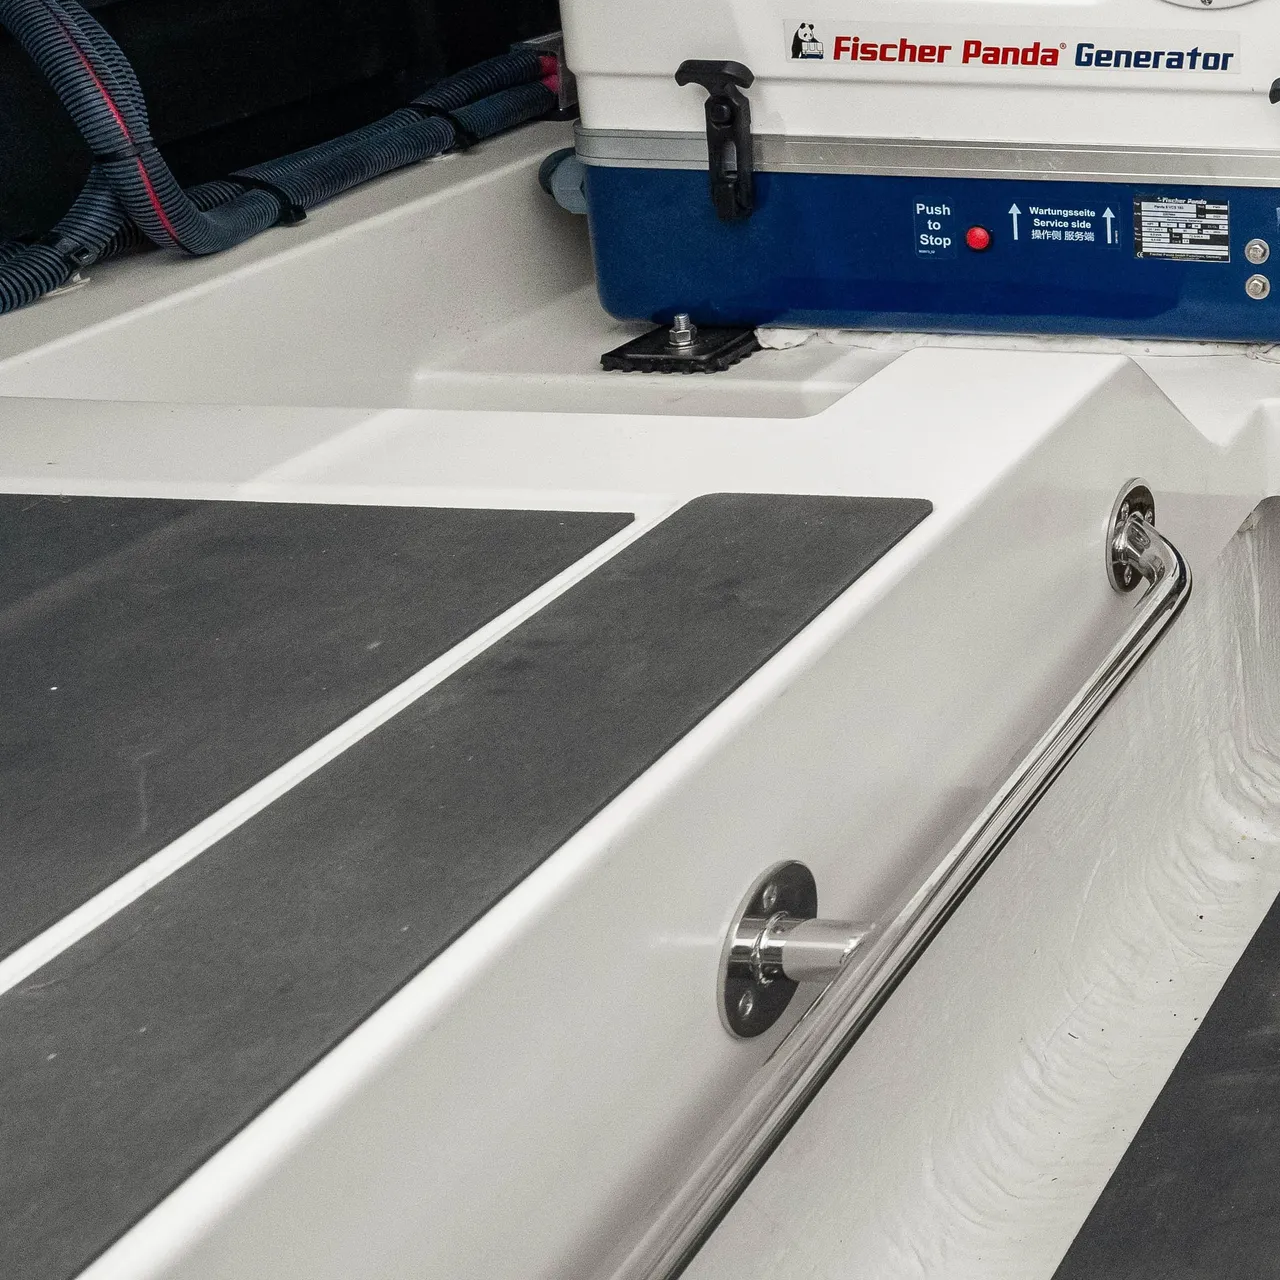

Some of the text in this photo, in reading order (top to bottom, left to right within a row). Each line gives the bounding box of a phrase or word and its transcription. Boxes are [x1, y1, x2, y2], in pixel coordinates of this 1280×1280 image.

[833, 36, 952, 64] Fischer
[1075, 42, 1235, 71] Generator
[916, 203, 951, 216] Push
[1029, 206, 1096, 219] Wartungsseite
[927, 220, 941, 231] to
[1033, 218, 1092, 229] Service side
[919, 233, 952, 248] Stop
[1031, 229, 1095, 242] 操作侧 服务端
